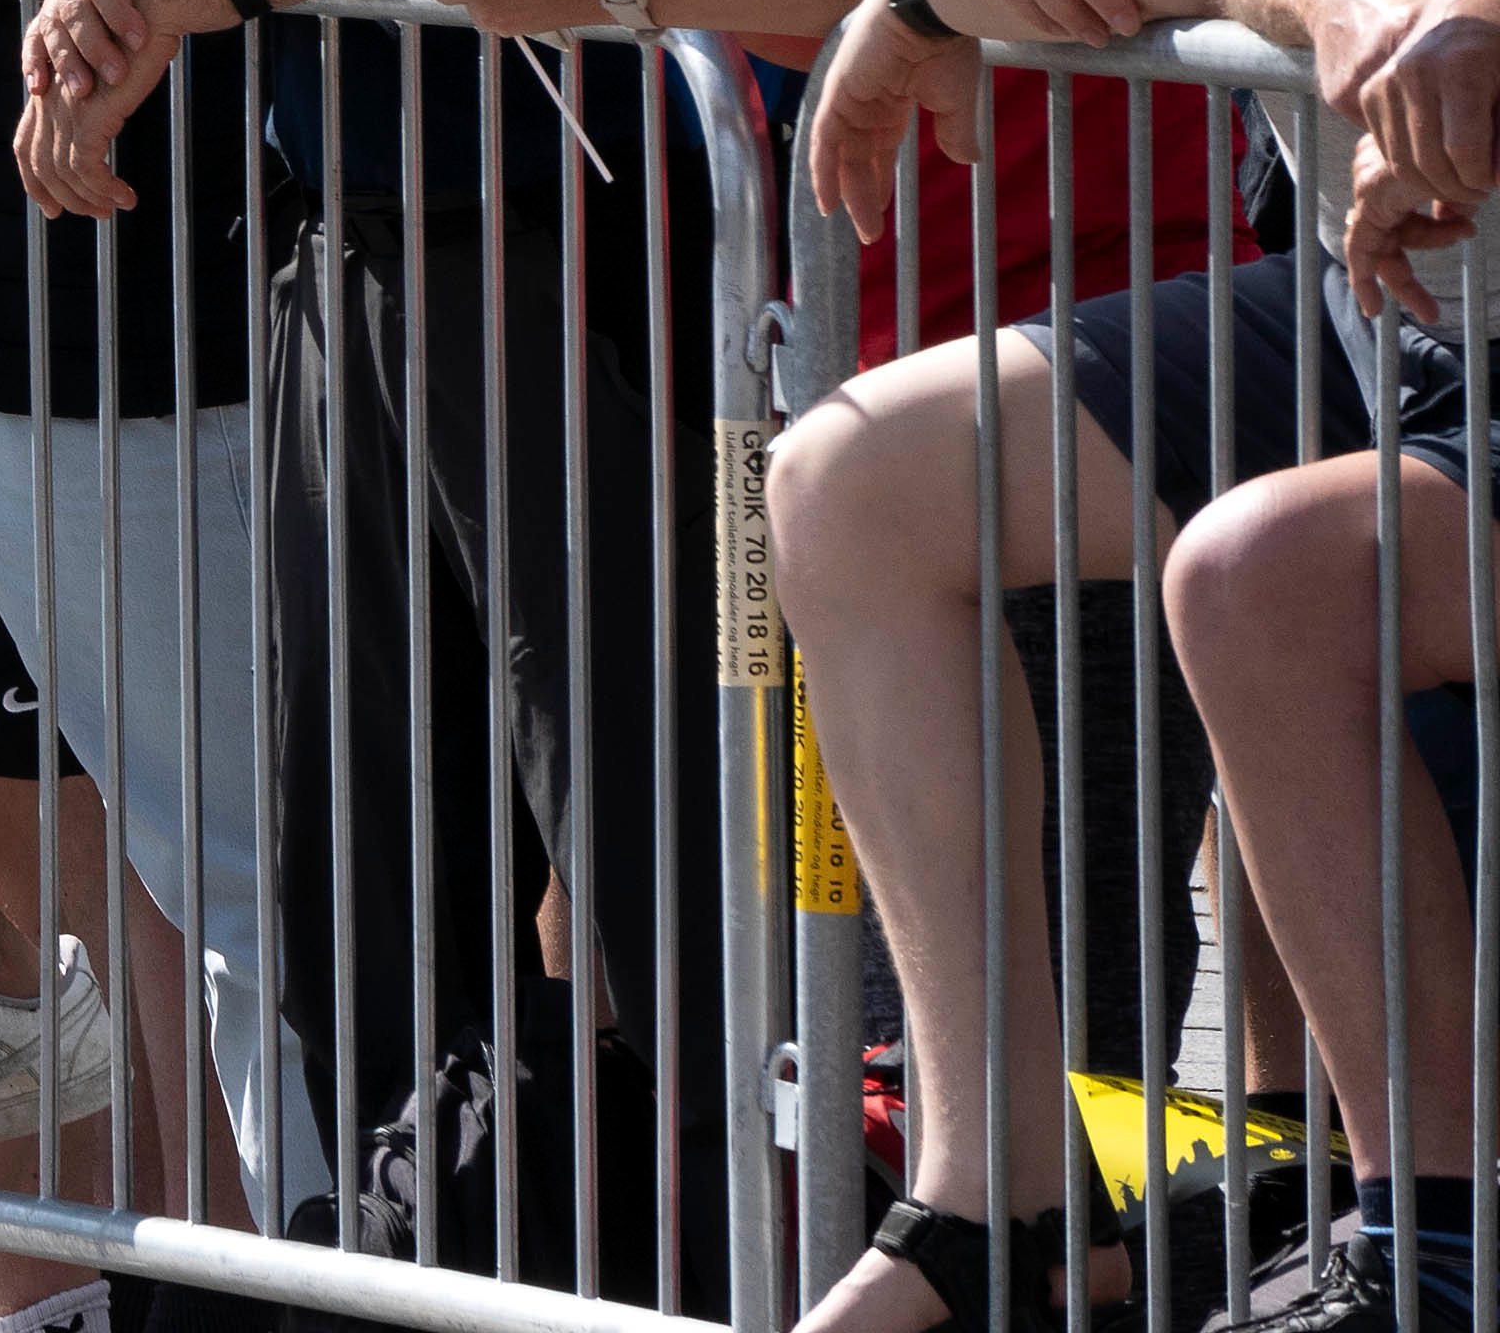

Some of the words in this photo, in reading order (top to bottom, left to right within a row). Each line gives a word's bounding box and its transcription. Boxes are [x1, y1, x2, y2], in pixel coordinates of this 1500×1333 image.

[724, 431, 736, 487] Udlejning
[727, 492, 737, 507] af
[727, 512, 738, 566] toiletter,
[745, 533, 767, 565] 70
[728, 571, 739, 621] moduler
[747, 572, 768, 602] 20
[728, 626, 738, 643] og
[747, 610, 769, 639] 18
[728, 647, 740, 678] hegn
[747, 648, 770, 677] 16
